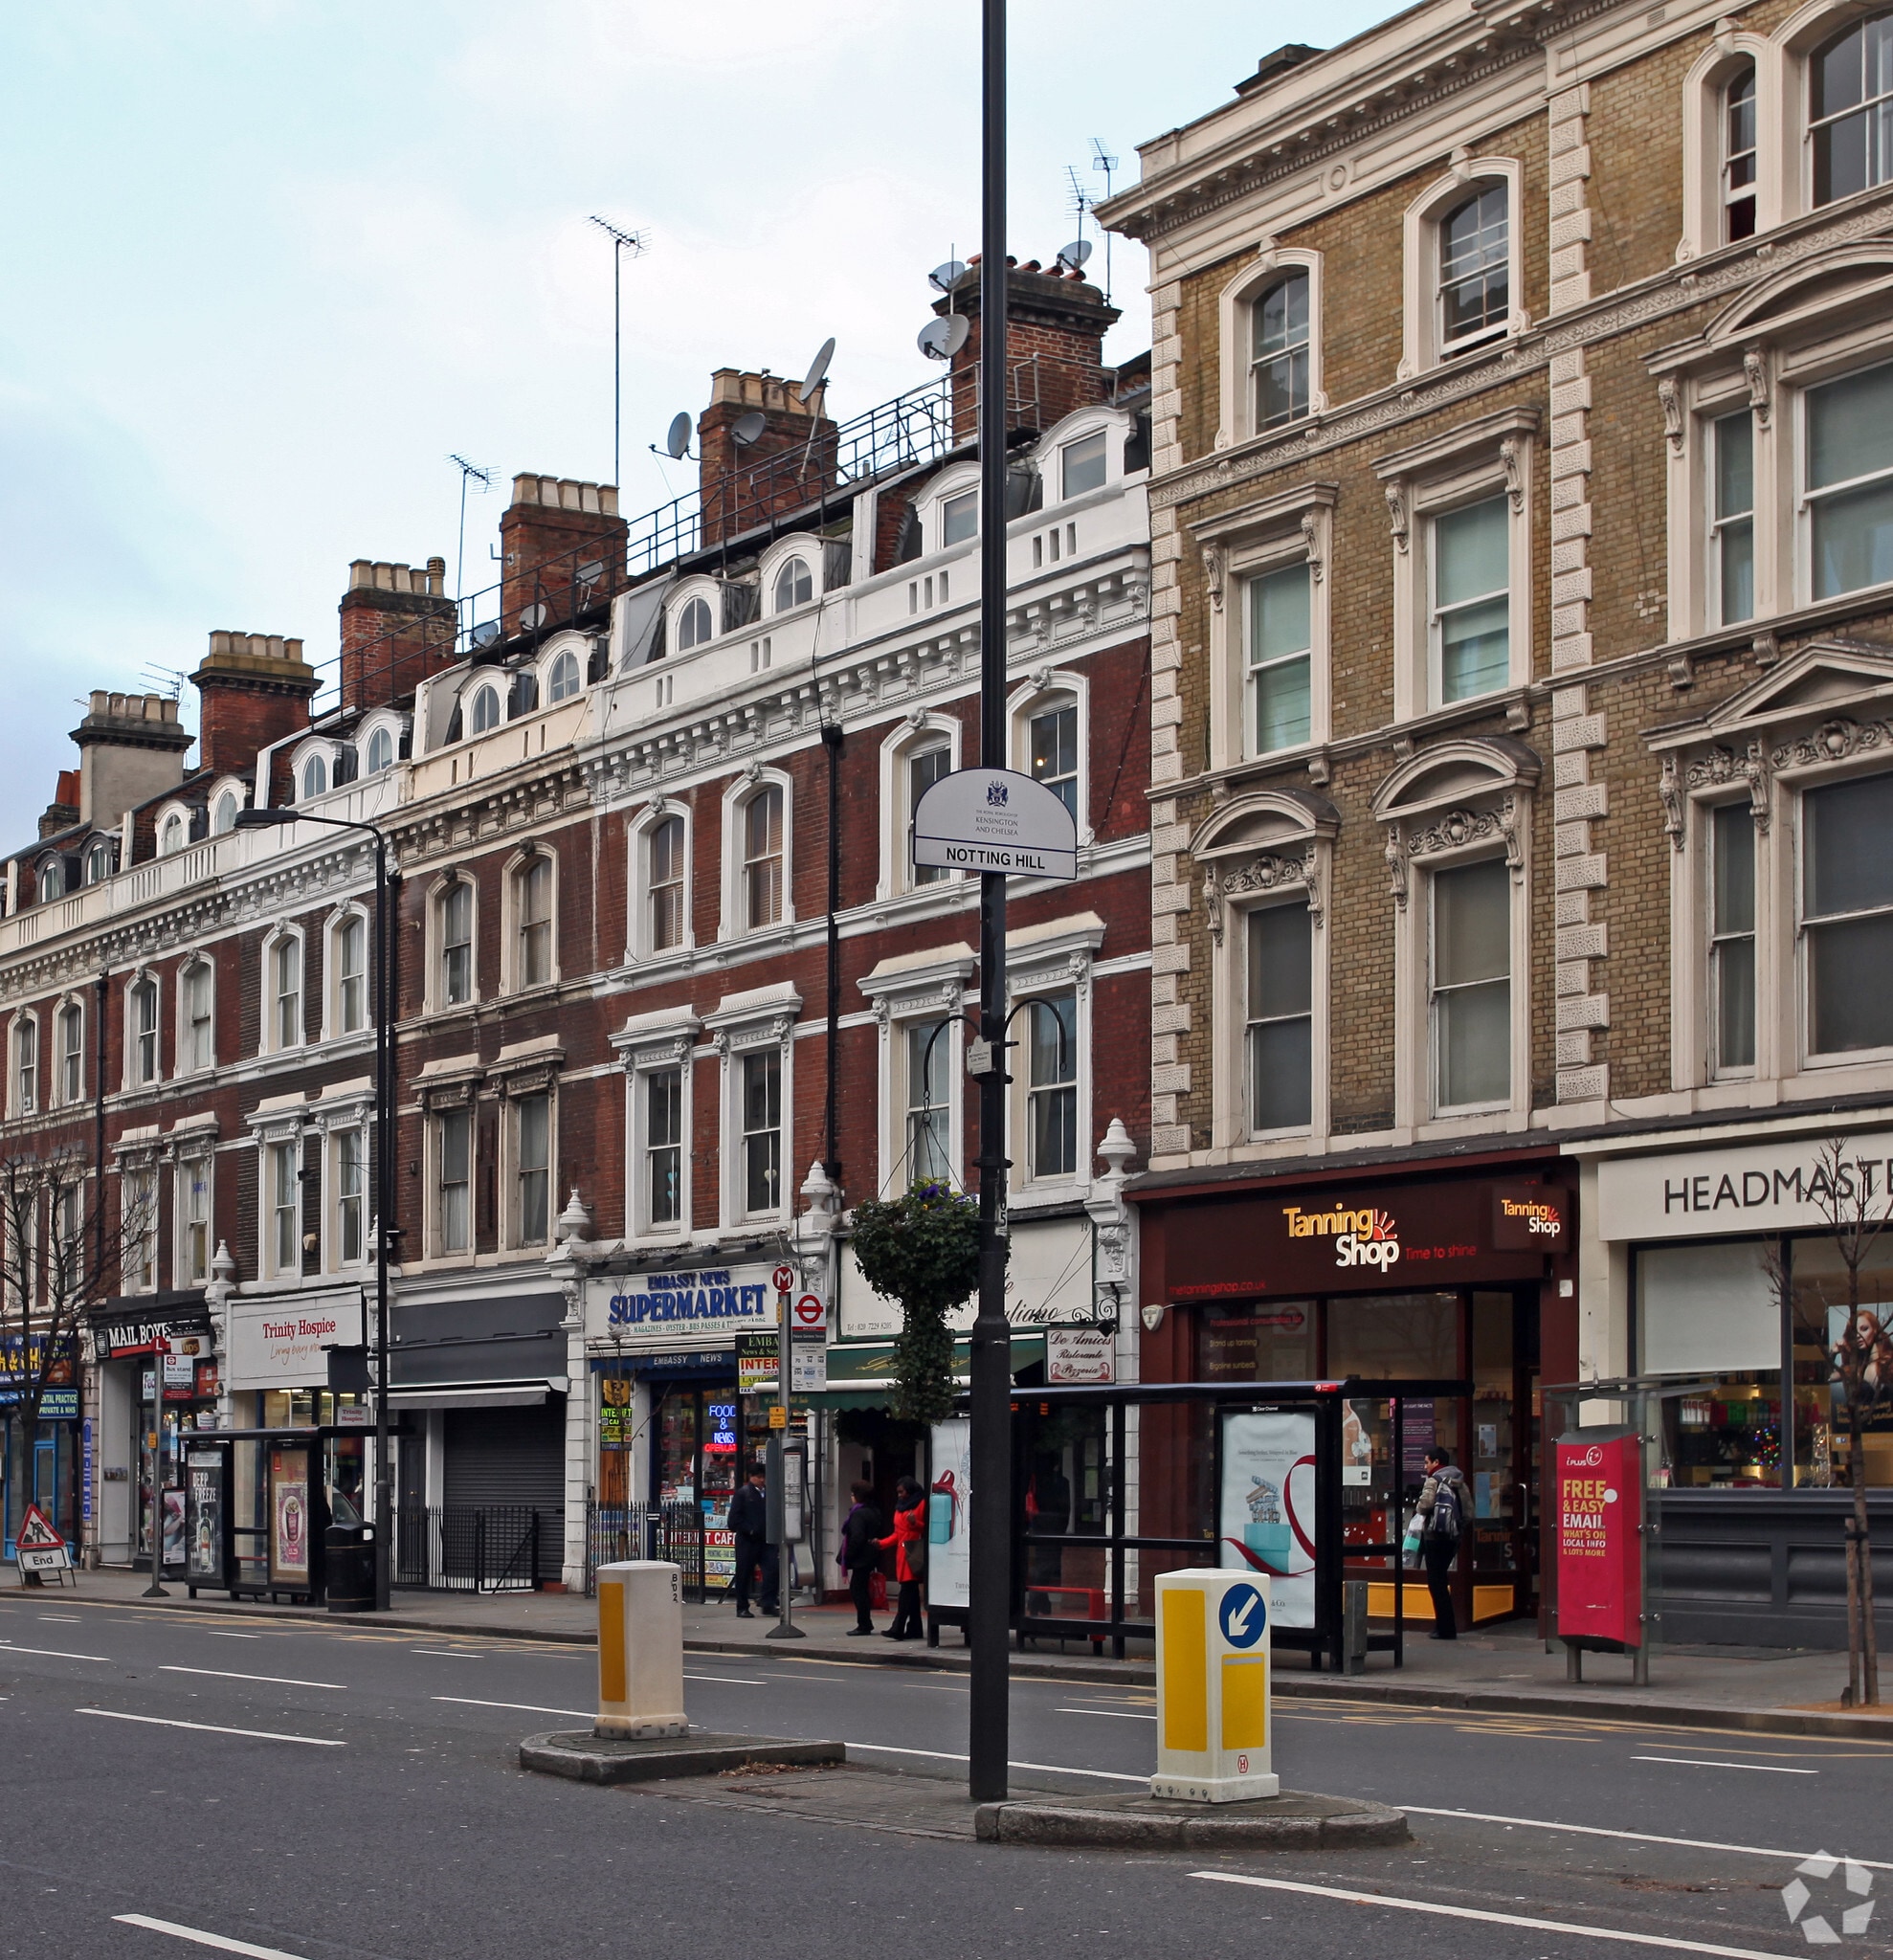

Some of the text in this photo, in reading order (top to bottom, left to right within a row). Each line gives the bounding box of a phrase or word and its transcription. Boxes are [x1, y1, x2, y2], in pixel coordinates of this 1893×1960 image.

[975, 816, 1018, 827] KENSINGTON
[991, 827, 1018, 836] CHELSEA
[946, 847, 1045, 870] NOTTING HILL
[1502, 1199, 1548, 1220] Tanning
[1282, 1203, 1373, 1240] Tanning
[1528, 1216, 1561, 1237] Shop
[1335, 1235, 1400, 1273] Shop
[1405, 1244, 1476, 1260] Time to shine
[648, 1270, 730, 1290] EMBASSY NEWS
[777, 1271, 791, 1286] M
[609, 1283, 767, 1324] SUPERMARKET
[262, 1317, 336, 1341] Trinity Hospice
[634, 1325, 662, 1333] MAGAZINES
[701, 1321, 721, 1329] PASSES
[108, 1325, 138, 1348] MAIL
[748, 1336, 778, 1347] EMBA
[1050, 1331, 1068, 1346] De
[156, 1339, 163, 1350] L
[182, 1343, 198, 1353] ups
[270, 1344, 290, 1366] Living
[654, 1353, 723, 1365] EMBASSY NEWS
[1057, 1348, 1103, 1359] Ristorante
[741, 1359, 778, 1370] INTER
[1061, 1364, 1099, 1375] Pizzeria
[56, 1393, 77, 1403] PRACTICE
[38, 1406, 59, 1414] PRIVATE
[60, 1406, 65, 1414] &
[720, 1417, 727, 1430] &
[714, 1432, 734, 1443] NEWS
[192, 1472, 209, 1487] DEEP
[194, 1487, 216, 1503] FREEZE
[1563, 1480, 1606, 1499] FREE
[1563, 1500, 1606, 1513] & EASY
[1563, 1513, 1605, 1529] EMAIL
[1563, 1528, 1606, 1539] WHAT'S ON
[1563, 1538, 1606, 1548] LOCAL INFO
[1568, 1548, 1583, 1556] LOTS
[33, 1555, 54, 1566] End
[1239, 1757, 1246, 1771] H
